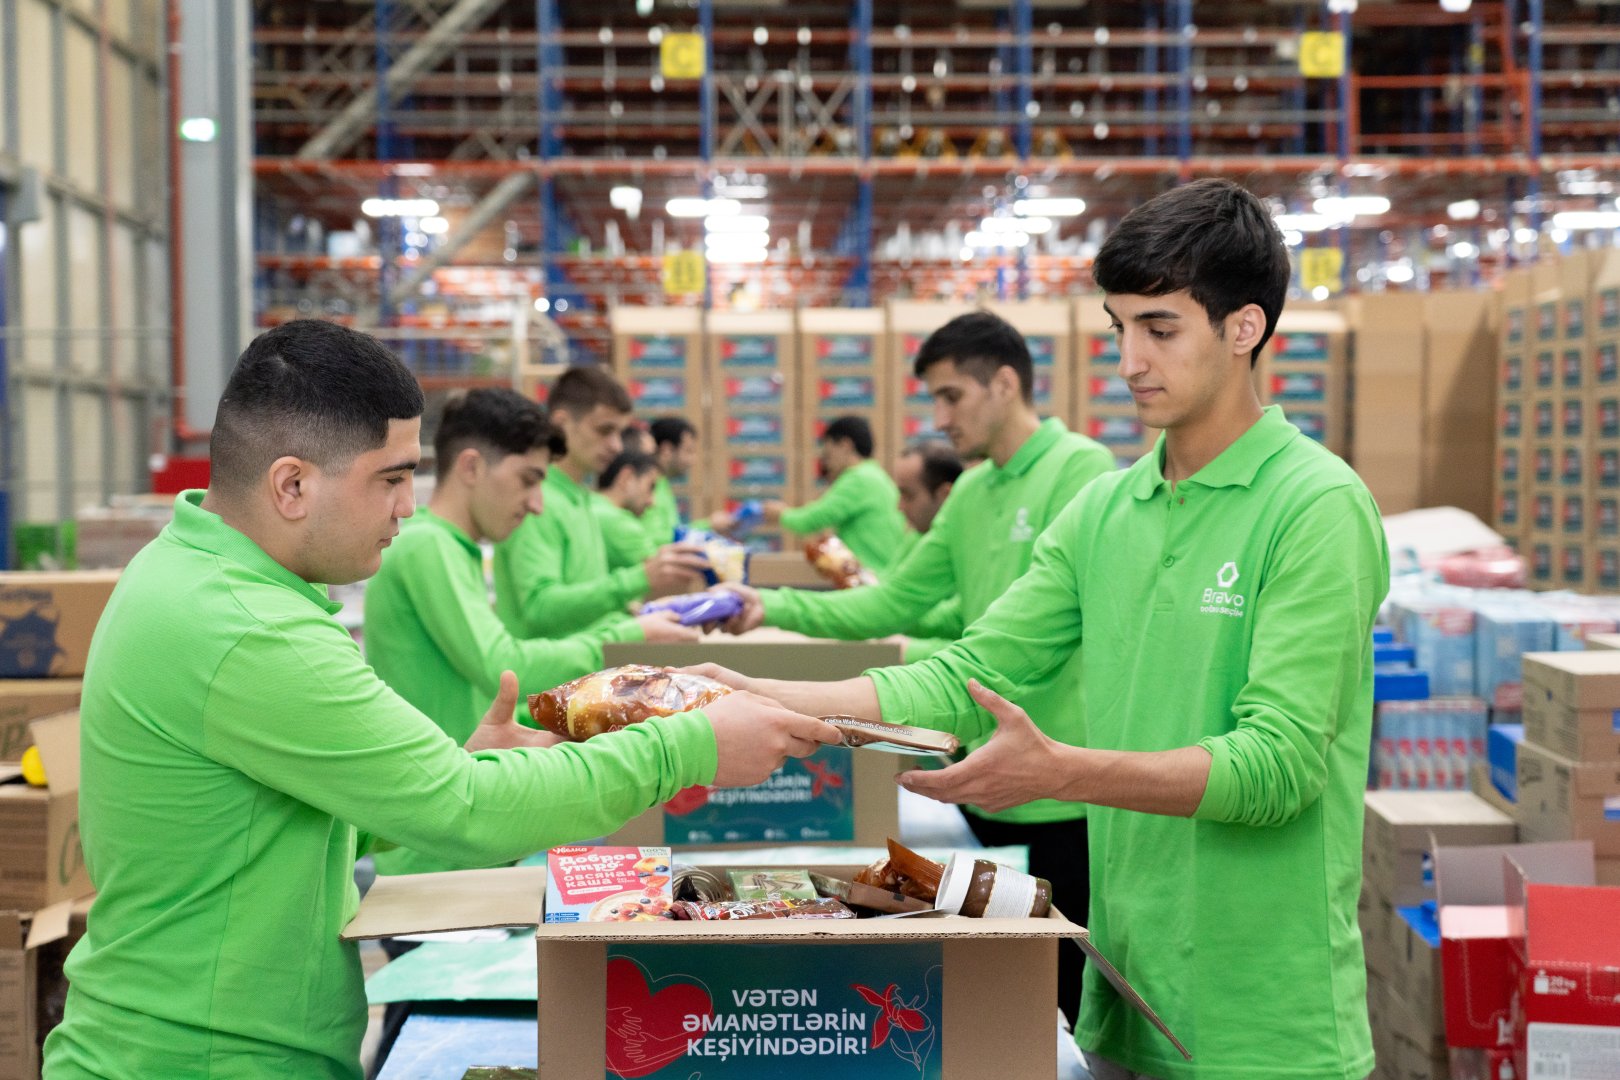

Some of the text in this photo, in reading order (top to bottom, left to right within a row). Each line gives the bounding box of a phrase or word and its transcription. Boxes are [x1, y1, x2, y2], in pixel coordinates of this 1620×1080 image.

[1202, 588, 1244, 607] Bravo
[842, 718, 861, 727] Wafer
[861, 721, 874, 729] with
[874, 723, 893, 733] Cocoa
[893, 728, 913, 737] Cream
[558, 853, 638, 867] Доброе
[565, 878, 613, 888] каша
[731, 988, 817, 1007] VƏTƏN
[682, 1008, 866, 1032] ƏMANƏTLƏRİN
[687, 1032, 867, 1062] KEŞİYİNDƏDİR!
